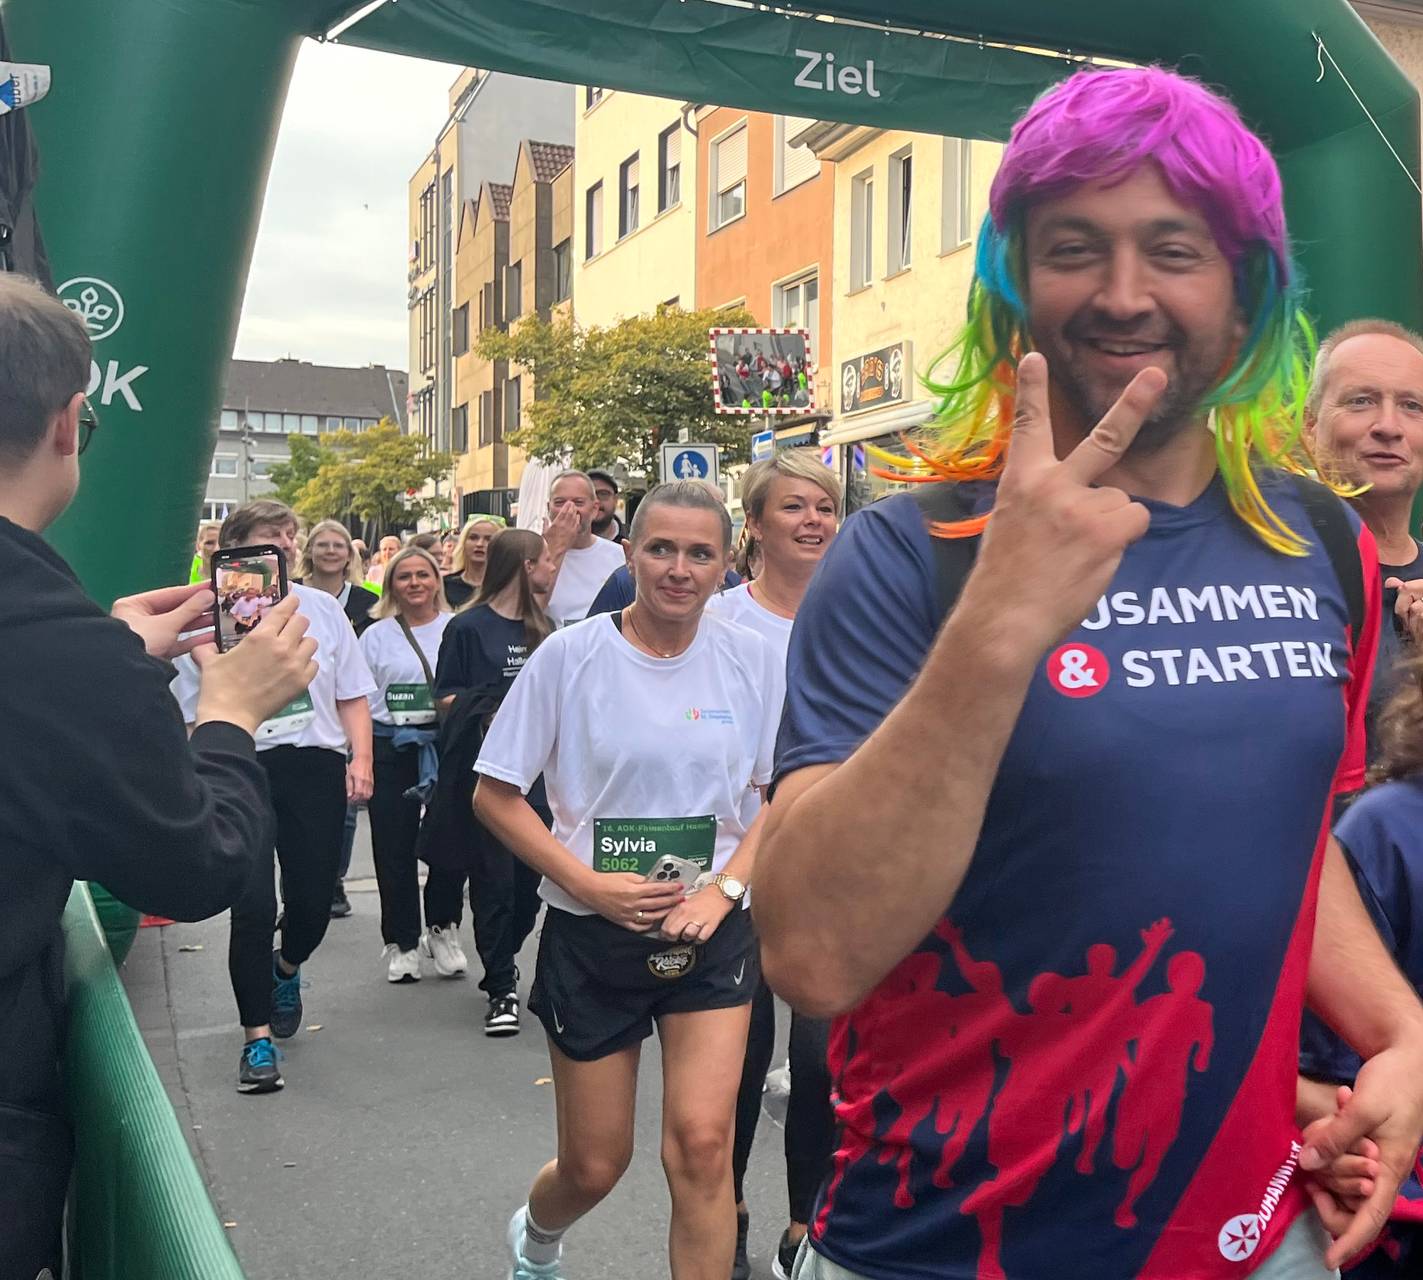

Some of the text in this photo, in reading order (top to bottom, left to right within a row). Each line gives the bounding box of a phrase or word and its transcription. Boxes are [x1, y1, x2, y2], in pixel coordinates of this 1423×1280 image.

[794, 48, 880, 97] Ziel
[1081, 585, 1319, 630] USAMMEN
[1058, 641, 1338, 689] & STARTEN
[601, 837, 656, 856] Sylvia
[601, 858, 639, 871] 5062
